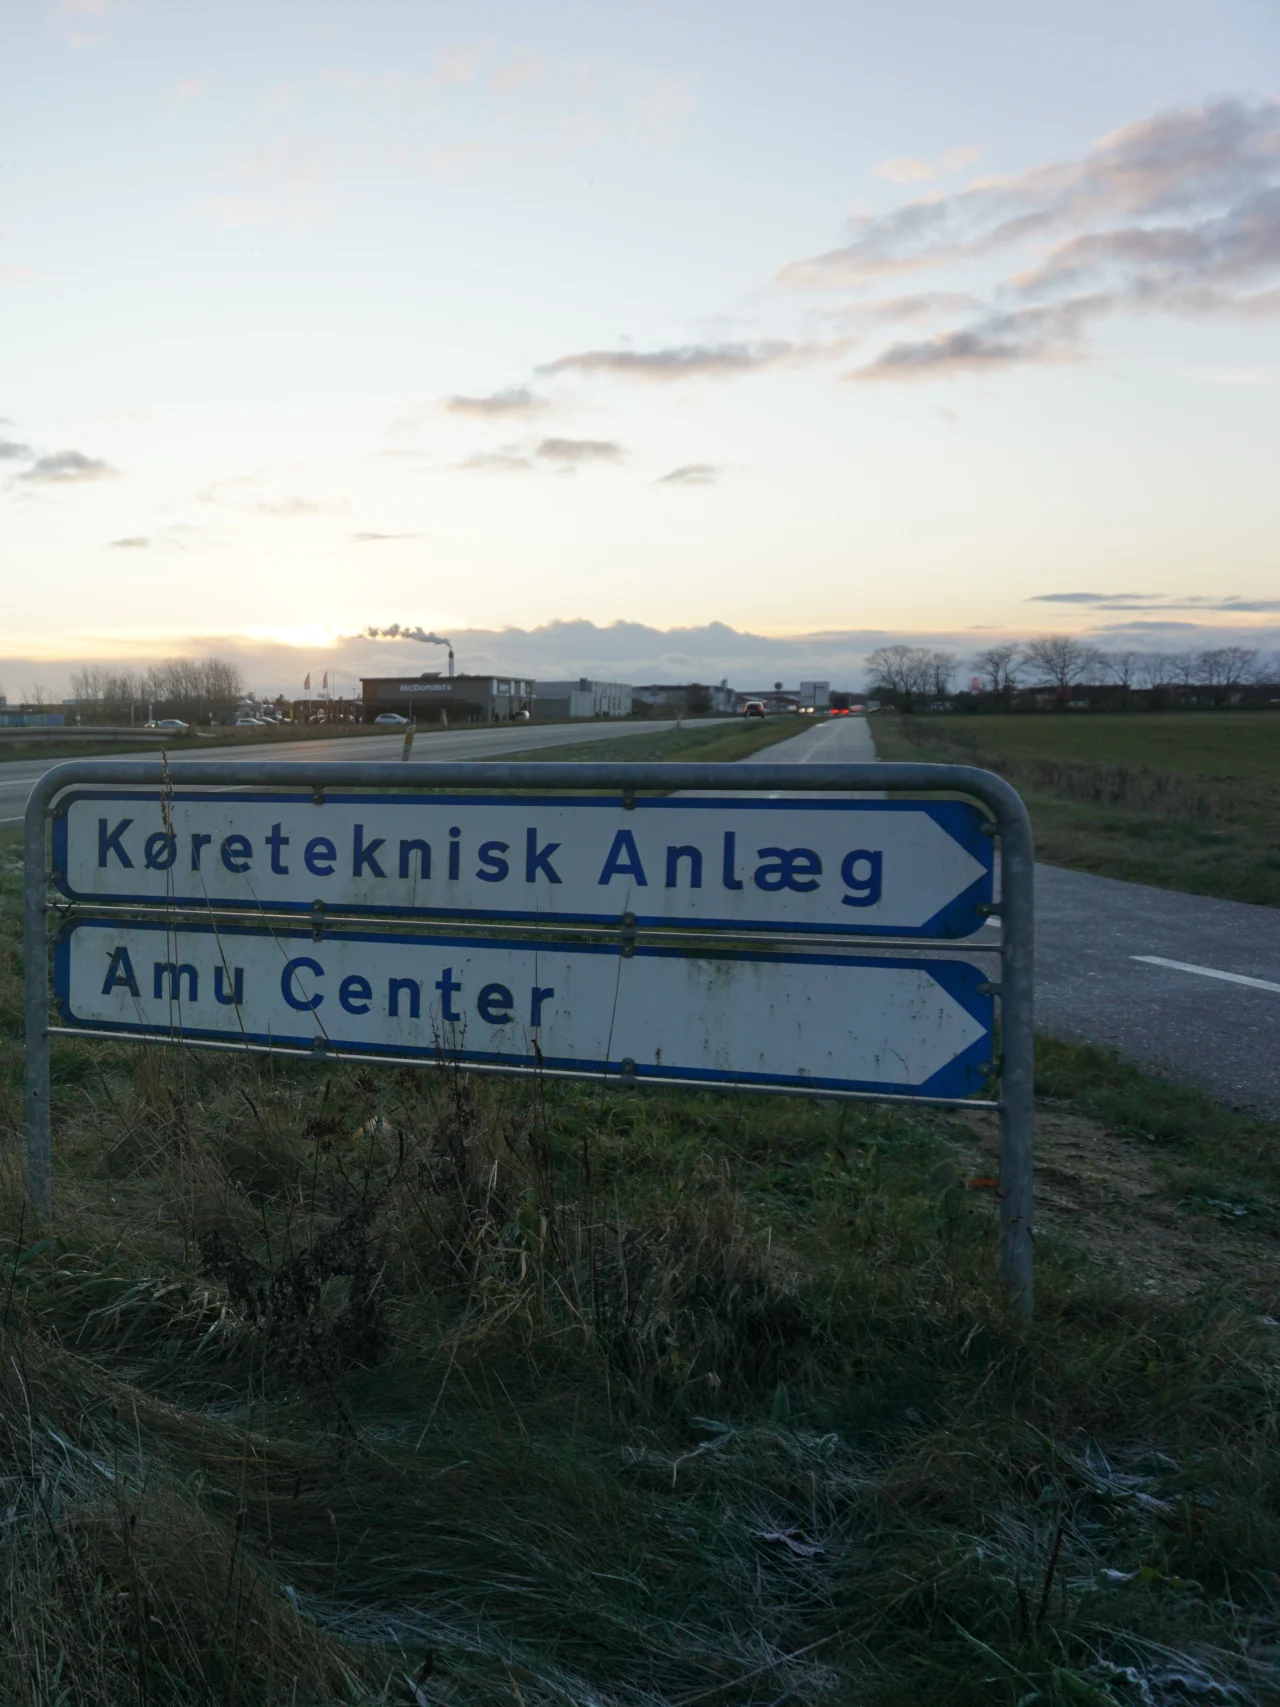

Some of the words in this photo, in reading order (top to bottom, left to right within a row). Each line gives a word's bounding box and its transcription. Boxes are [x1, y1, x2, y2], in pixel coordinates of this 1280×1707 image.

[400, 683, 452, 692] McDonald's
[97, 817, 563, 885] Køreteknisk
[598, 829, 884, 908] Anlæg
[101, 946, 245, 1006] Amu
[280, 956, 555, 1028] Center
